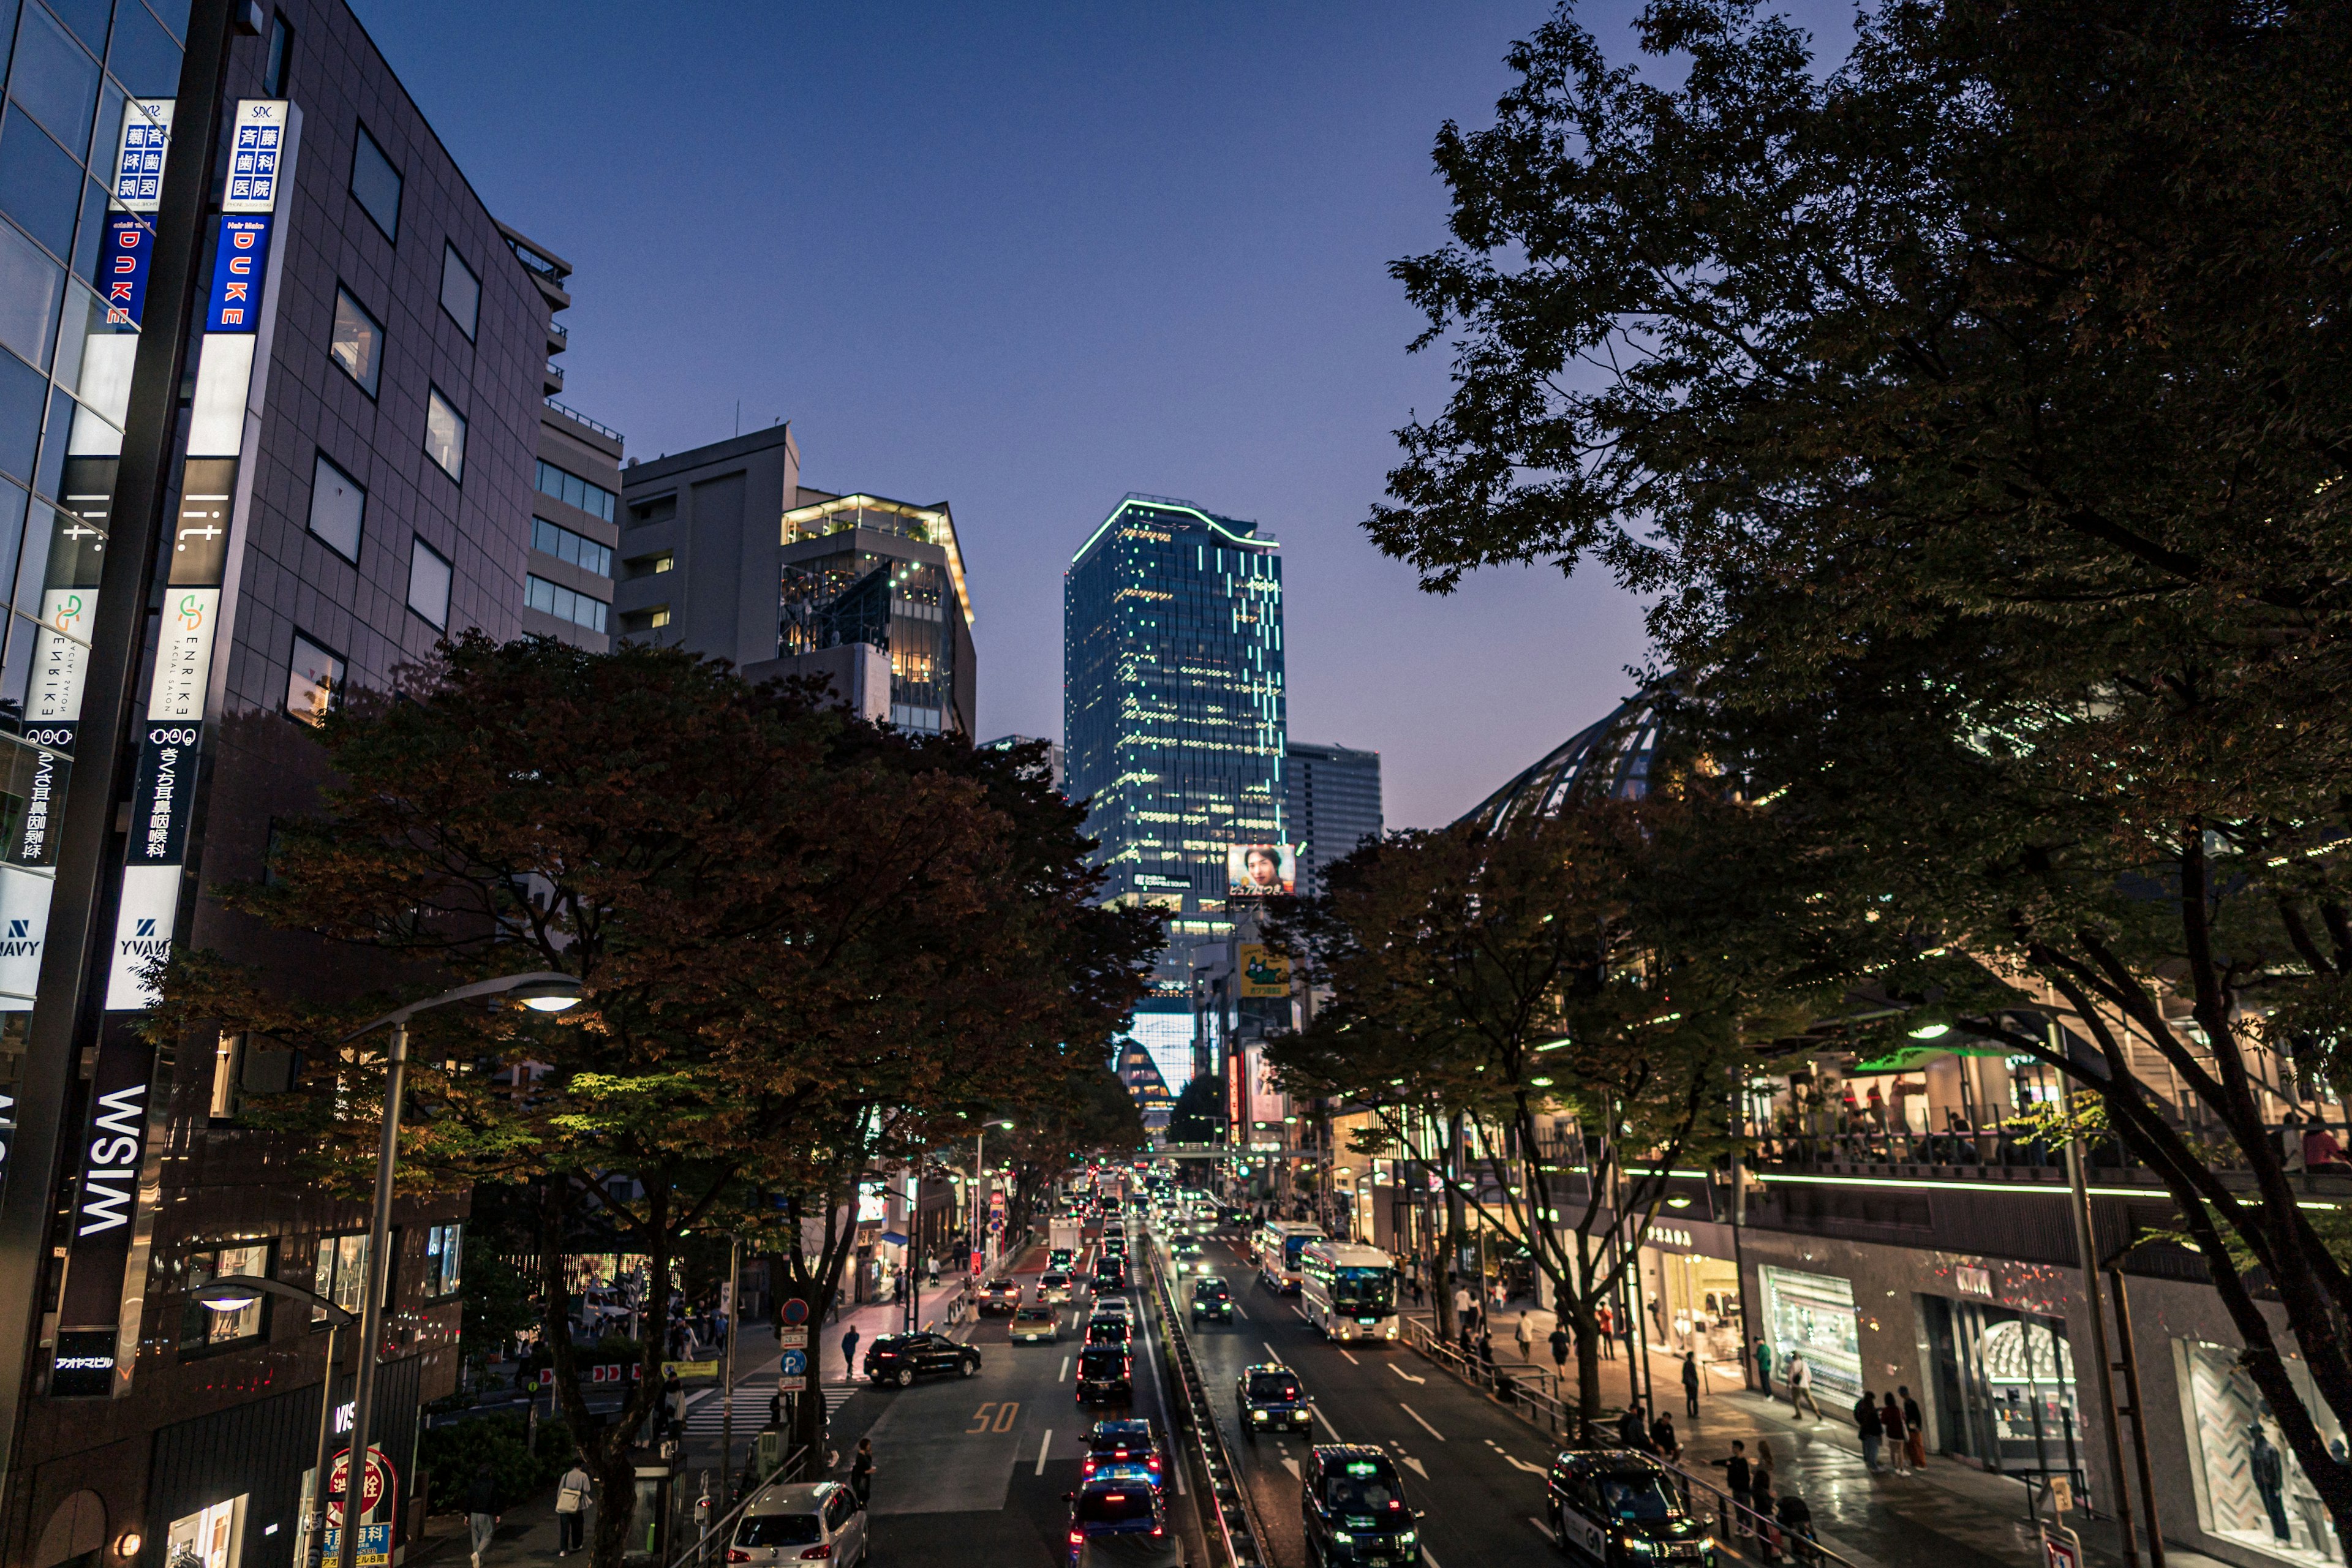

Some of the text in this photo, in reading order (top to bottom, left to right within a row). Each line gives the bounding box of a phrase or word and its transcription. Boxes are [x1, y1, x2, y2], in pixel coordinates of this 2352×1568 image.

[252, 106, 272, 118] SDC
[221, 232, 256, 325] DUKE
[164, 639, 180, 712] FACIAL SALON
[146, 747, 179, 858] きくち耳鼻咽喉科
[1647, 1225, 1692, 1248] PRADA
[55, 1357, 114, 1370] アオヤマビル
[785, 1357, 796, 1373] P
[965, 1402, 1020, 1433] 50
